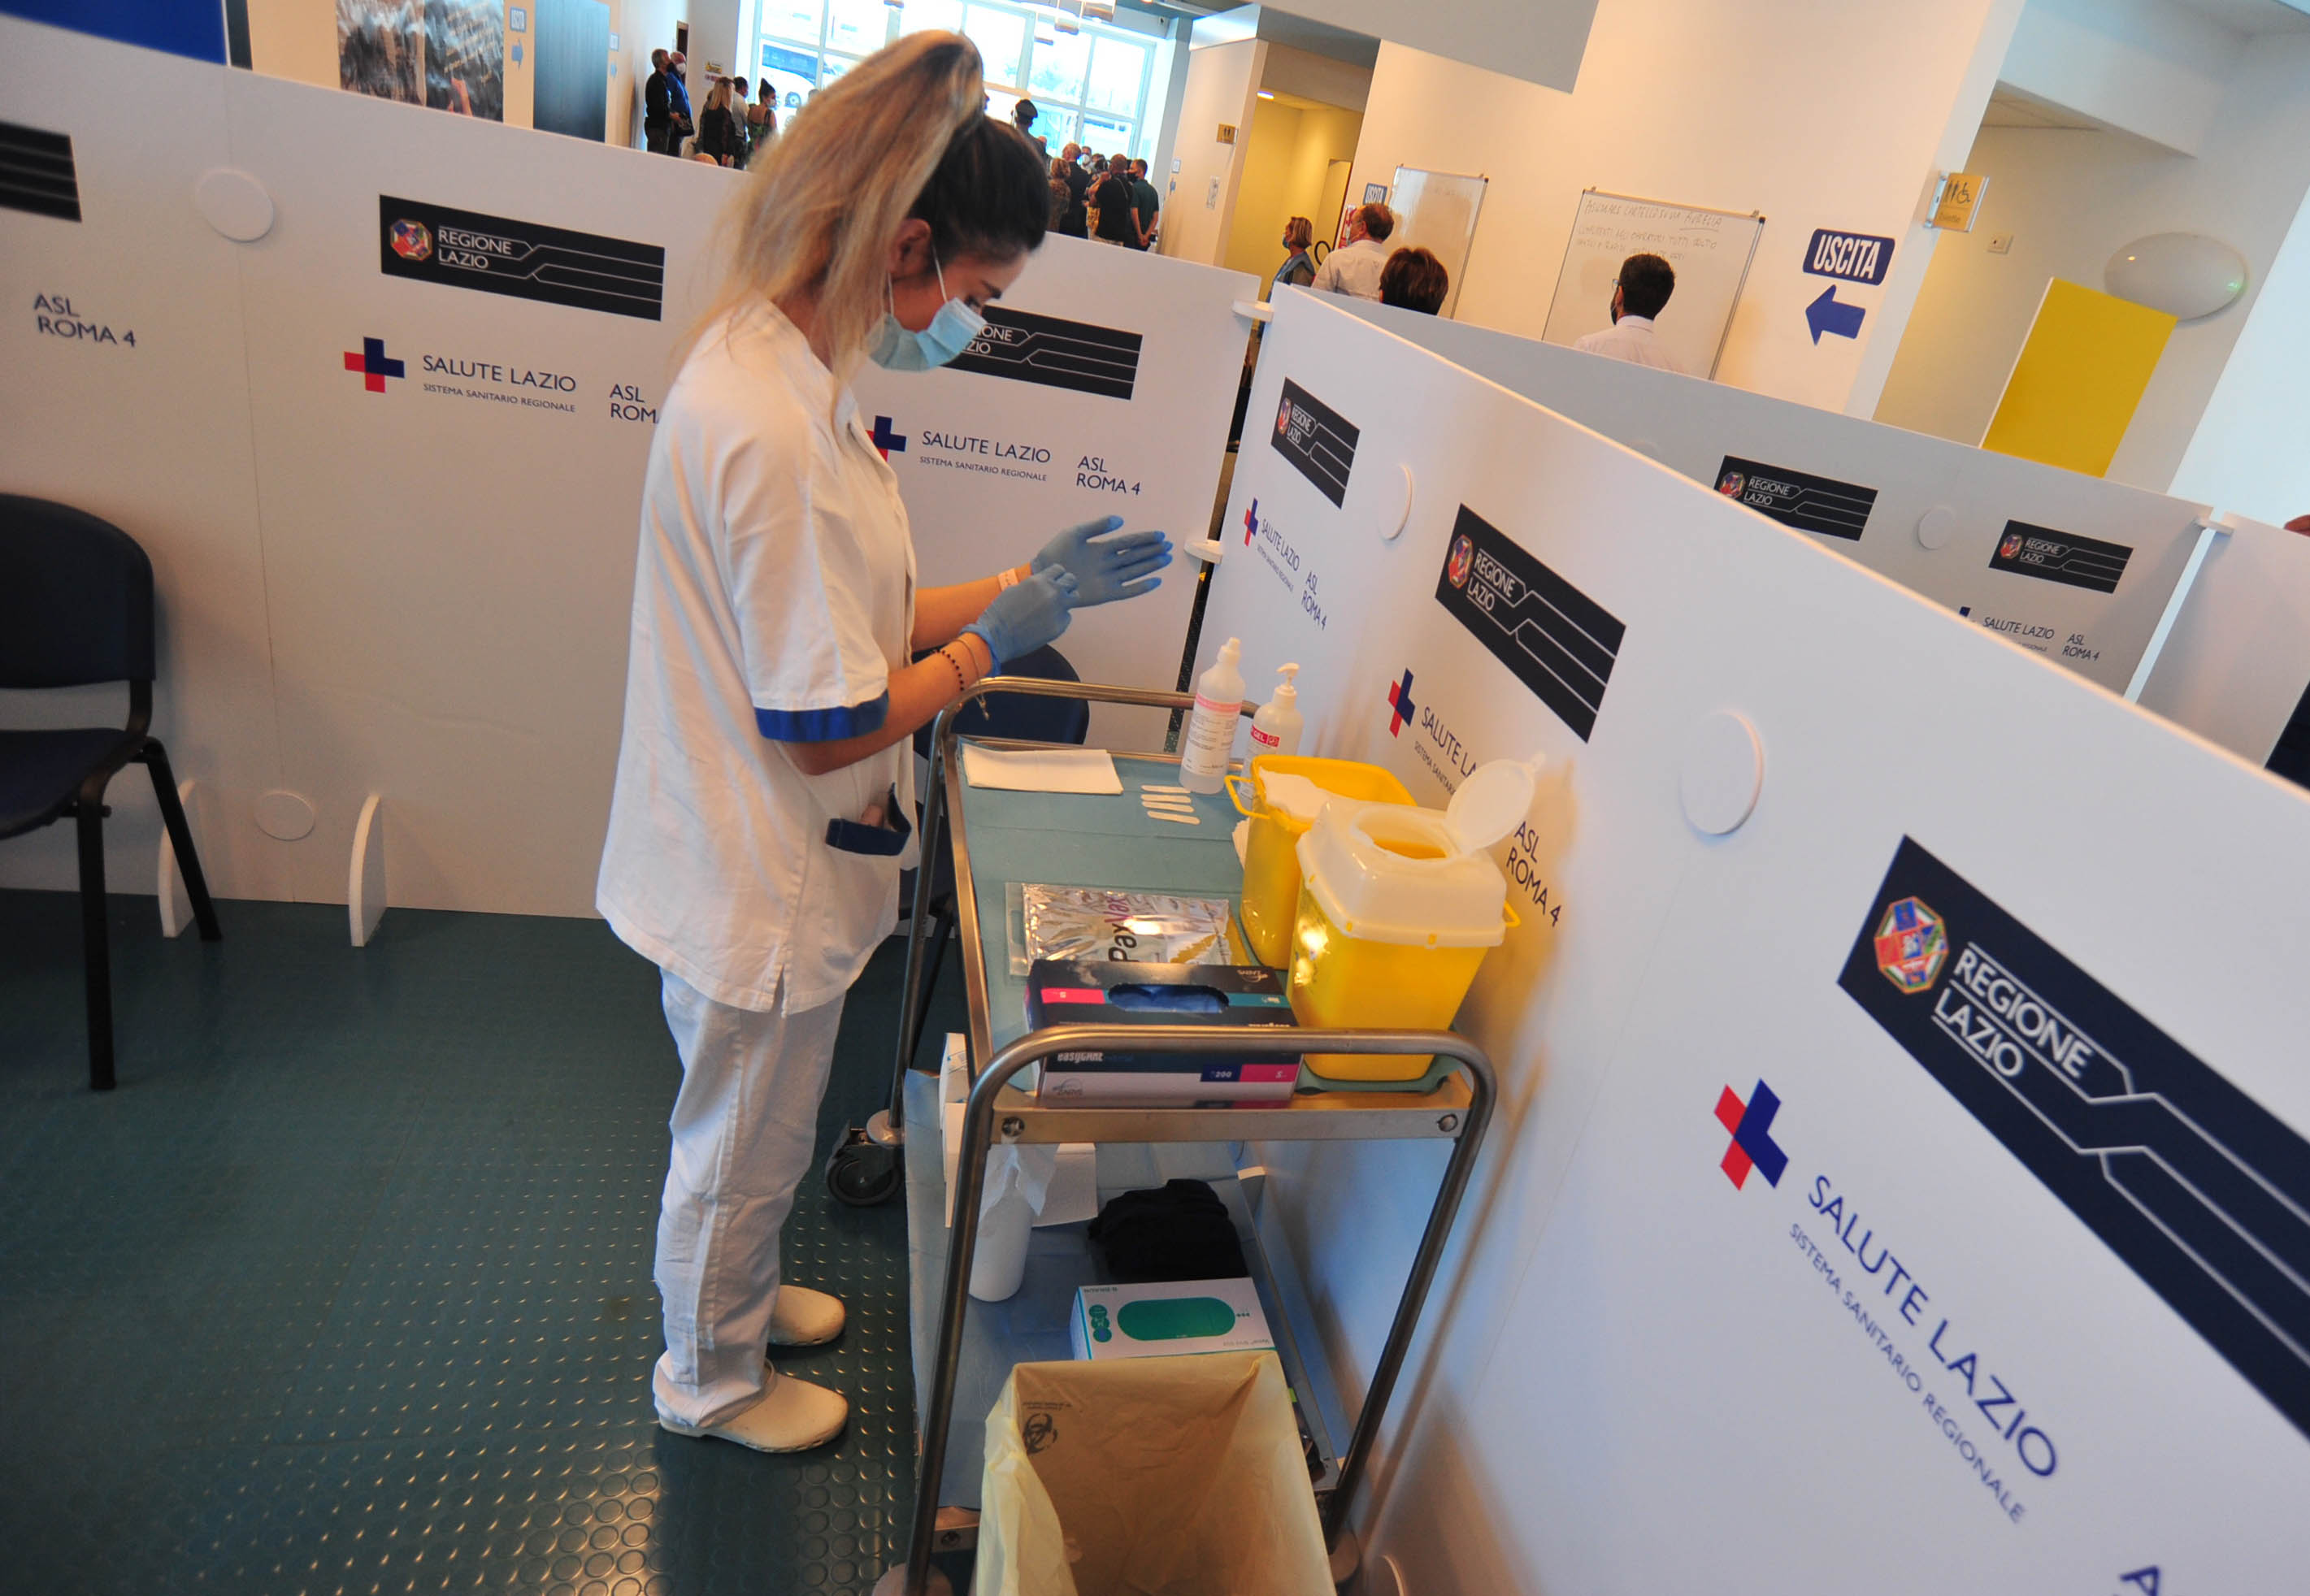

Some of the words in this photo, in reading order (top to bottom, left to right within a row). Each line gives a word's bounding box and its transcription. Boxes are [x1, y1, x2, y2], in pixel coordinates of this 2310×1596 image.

[438, 228, 513, 256] REGIONE
[438, 248, 489, 270] LAZIO
[1812, 234, 1882, 280] USCITA
[33, 293, 80, 318] ASL
[37, 314, 117, 345] ROMA
[123, 329, 137, 348] 4
[423, 354, 502, 383] SALUTE
[510, 367, 577, 392] LAZIO
[423, 383, 464, 397] SISTEMA
[466, 388, 519, 405] SANITARIO
[520, 397, 576, 413] REGIONALE
[610, 384, 645, 403] ASL
[610, 403, 659, 423] ROM
[1291, 406, 1312, 434] REGIONE
[921, 430, 989, 455] SALUTE
[995, 441, 1051, 464] LAZIO
[1287, 425, 1301, 445] LAZIO
[919, 455, 953, 468] SISTEMA
[955, 460, 999, 475] SANITARIO
[1001, 467, 1048, 482] REGIONALE
[1077, 455, 1108, 473] ASL
[1075, 472, 1127, 494] ROMA
[1131, 482, 1141, 496] 4
[1748, 478, 1791, 497] REGIONE
[1743, 491, 1773, 506] LAZIO
[1261, 518, 1282, 552] SALUTE
[1280, 540, 1300, 571] LAZIO
[2020, 551, 2045, 564] LAZIO
[2025, 539, 2061, 555] REGIONE
[1305, 570, 1318, 596] ASL
[1474, 551, 1516, 598] REGIONE
[1467, 576, 1496, 612] LAZIO
[1301, 590, 1321, 627] ROMA
[1320, 615, 1327, 631] 4
[1982, 616, 2022, 634] SALUTE
[2021, 623, 2056, 640] LAZIO
[2066, 633, 2086, 646] ASL
[2061, 644, 2091, 661] ROMA
[2091, 652, 2100, 661] 4
[1421, 705, 1462, 765] SALUTE
[1513, 820, 1539, 864] ASL
[1505, 845, 1548, 916] ROMA
[1549, 904, 1562, 928] 4
[1952, 948, 2095, 1079] REGIONE
[1934, 987, 2025, 1078] LAZIO
[1808, 1175, 1930, 1326] SALUTE
[1928, 1318, 2058, 1477] LAZIO
[1788, 1223, 1841, 1295] SISTEMA
[1841, 1290, 1922, 1393] SANITARIO
[1922, 1392, 2026, 1524] REGIONALE
